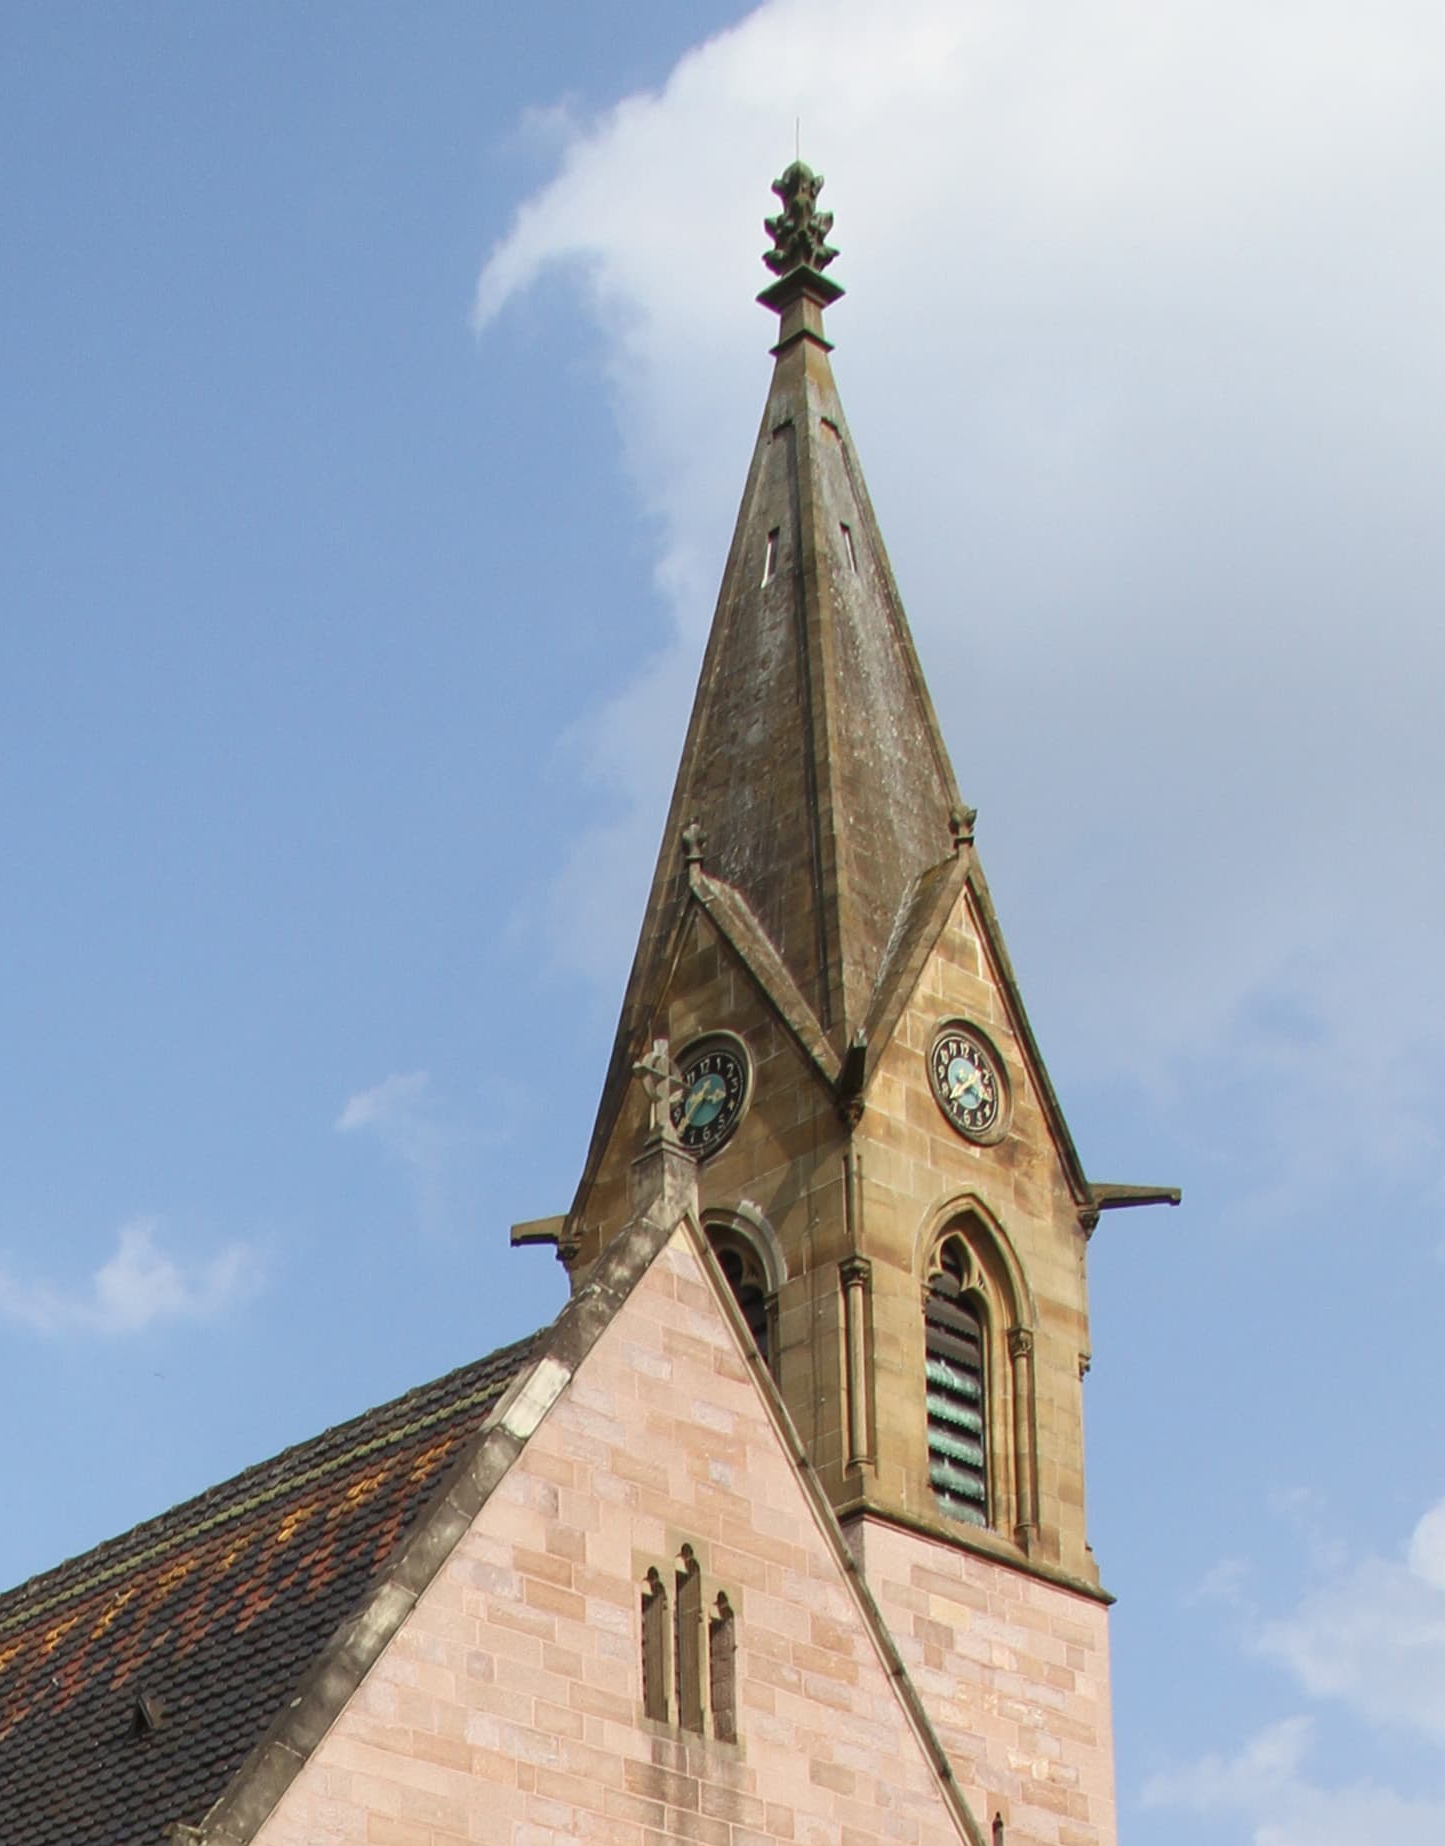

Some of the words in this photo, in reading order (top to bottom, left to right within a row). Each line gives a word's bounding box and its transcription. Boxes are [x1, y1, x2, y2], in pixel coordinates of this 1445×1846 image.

[949, 1042, 957, 1056] 11
[960, 1042, 969, 1058] 12
[700, 1058, 710, 1073] 12
[727, 1063, 734, 1078] 2
[938, 1065, 945, 1079] 9
[963, 1109, 971, 1127] 6
[703, 1126, 710, 1140] 6
